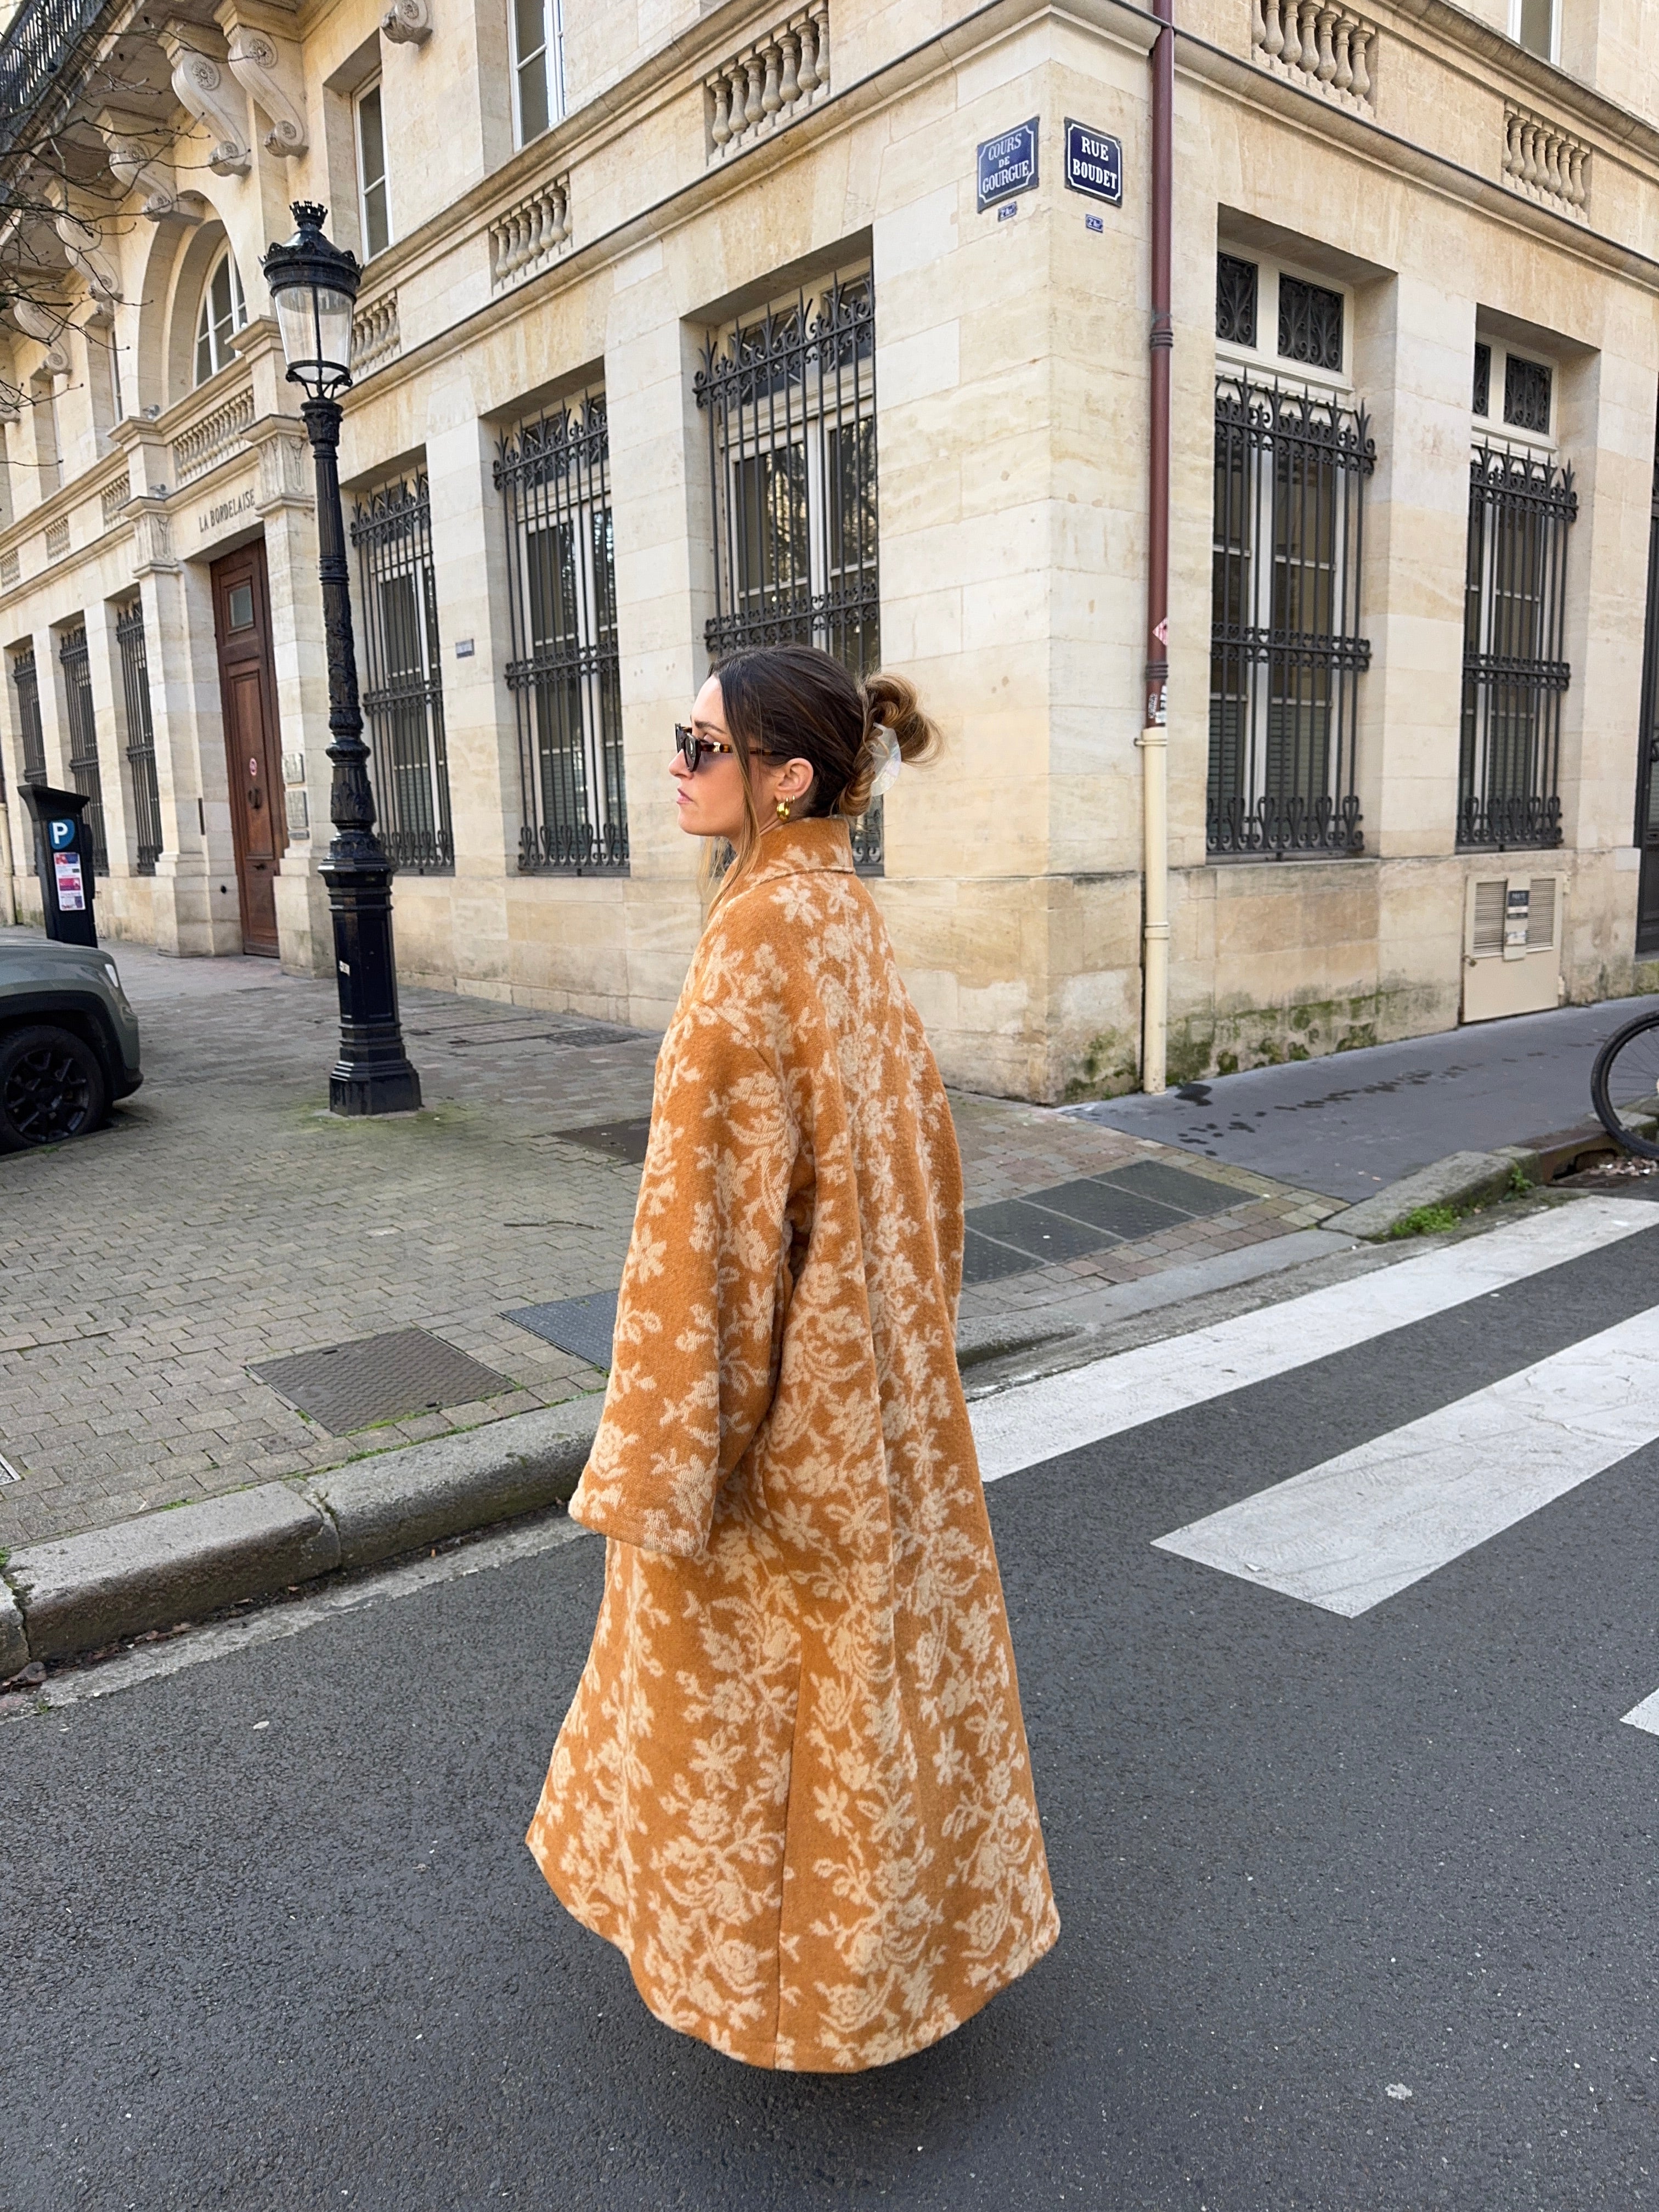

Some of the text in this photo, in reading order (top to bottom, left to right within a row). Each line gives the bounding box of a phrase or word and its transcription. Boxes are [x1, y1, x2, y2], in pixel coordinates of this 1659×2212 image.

[989, 133, 1022, 161] COURS
[1081, 136, 1109, 161] RUE
[998, 156, 1009, 168] DE
[1073, 158, 1117, 189] BOUDET
[982, 160, 1029, 194] GOURGUE
[199, 488, 255, 532] LA BORDELAISE
[52, 822, 68, 844] P
